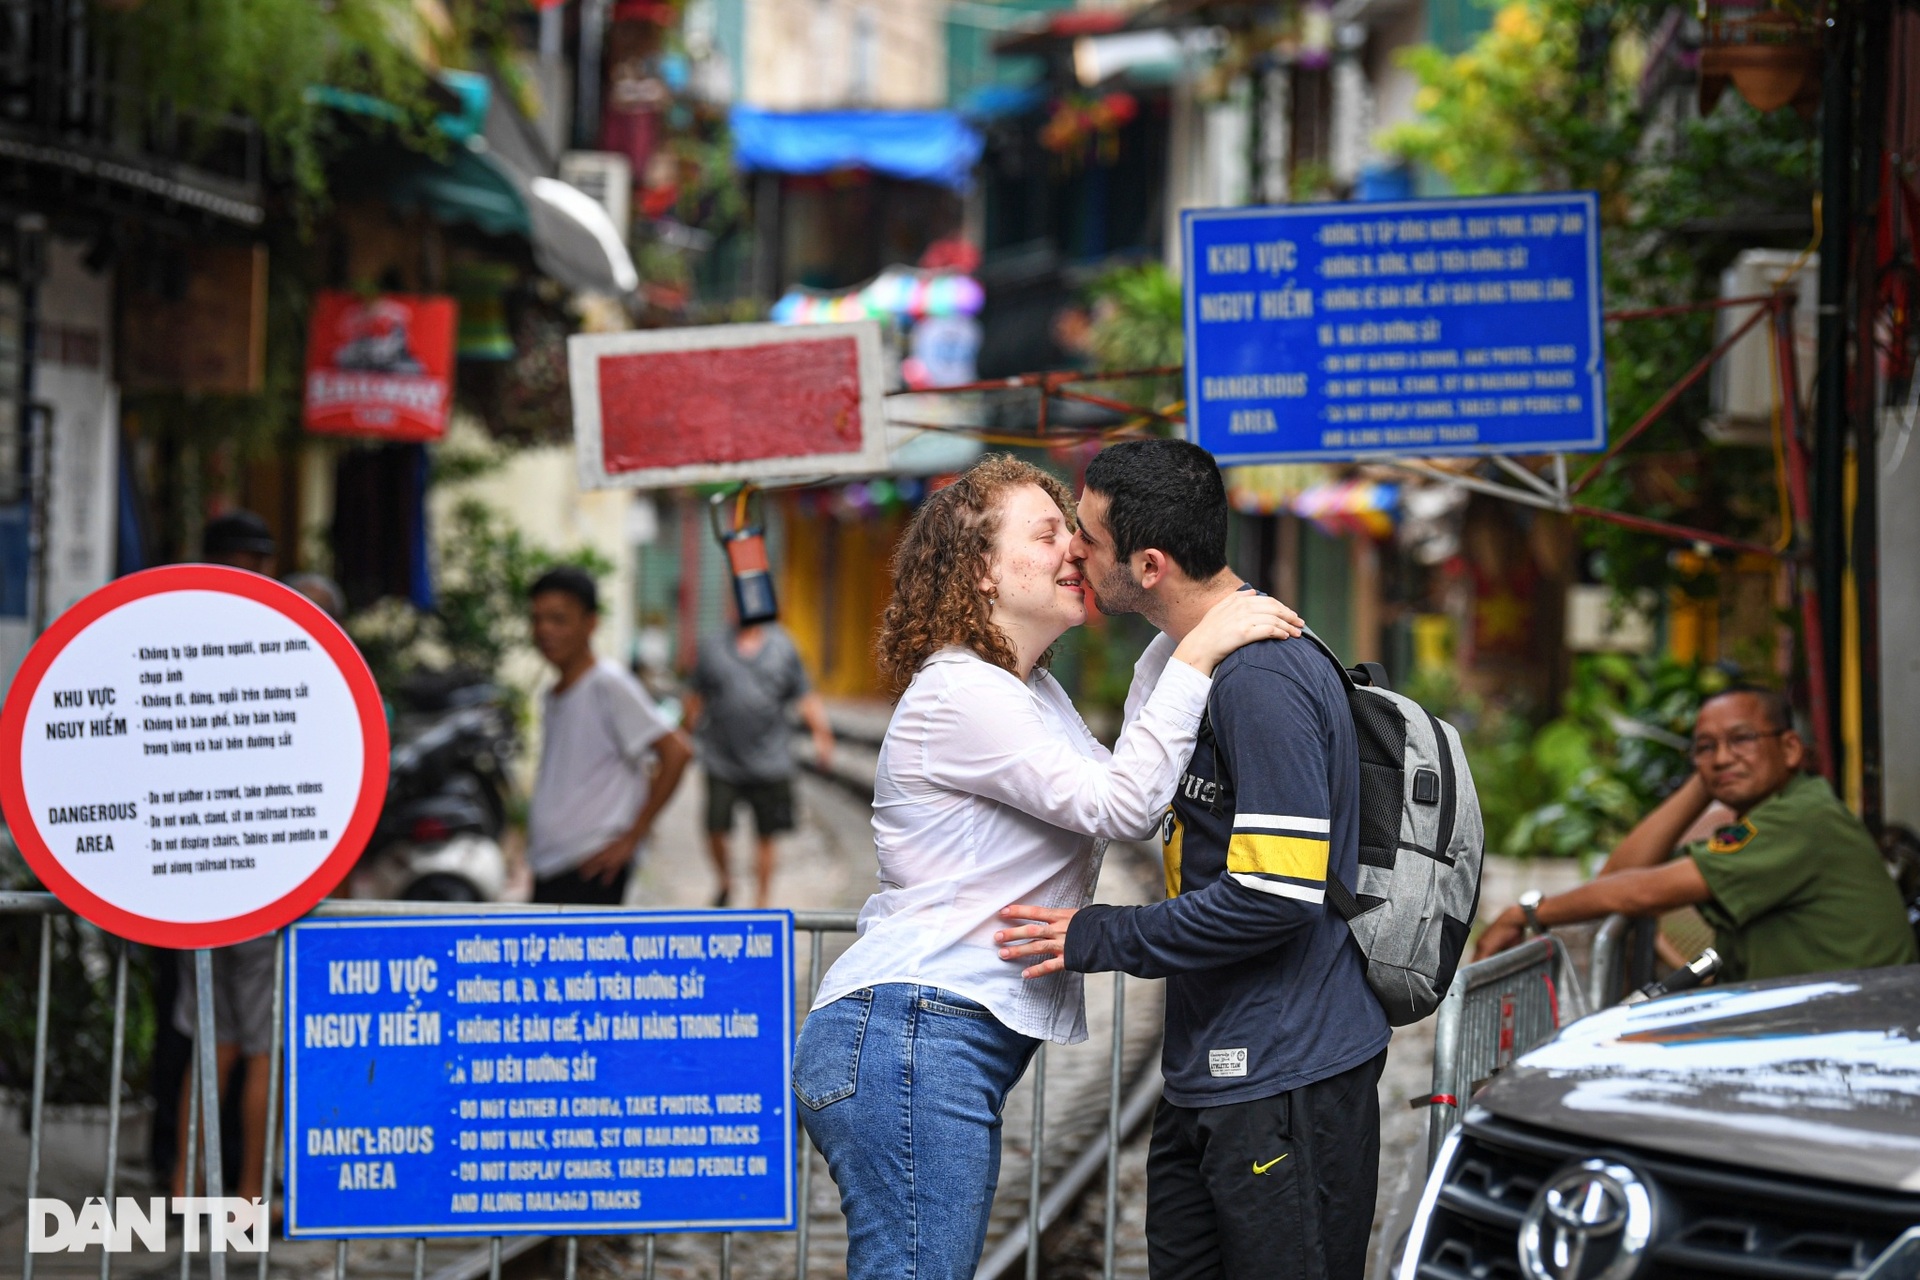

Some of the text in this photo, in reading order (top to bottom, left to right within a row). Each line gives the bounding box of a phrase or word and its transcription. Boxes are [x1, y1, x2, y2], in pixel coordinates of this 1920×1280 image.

[1207, 243, 1251, 275] KHU
[1254, 238, 1298, 279] VỰC
[1203, 372, 1308, 402] DANGEROUS
[54, 688, 116, 710] KHU VỰC
[46, 721, 84, 740] NGUY
[49, 802, 137, 825] DANGEROUS
[76, 834, 114, 853] AREA
[329, 955, 438, 1000] KHU VỰC
[304, 999, 441, 1048] NGUY HIỂM
[459, 1099, 478, 1119] DO
[480, 1098, 506, 1119] NOT
[508, 1097, 557, 1119] GATHER
[560, 1098, 570, 1117] A
[625, 1096, 657, 1116] TAKE
[659, 1094, 714, 1117] PHOTOS,
[715, 1093, 762, 1114] VIDEOS
[307, 1125, 434, 1156] DANGEROUS
[459, 1124, 760, 1151] DO NOT WALK, STAND, SIT ON RAILROAD TRACKS
[338, 1161, 397, 1191] AREA
[451, 1189, 641, 1213] AND ALONG RAILROAD TRACKS
